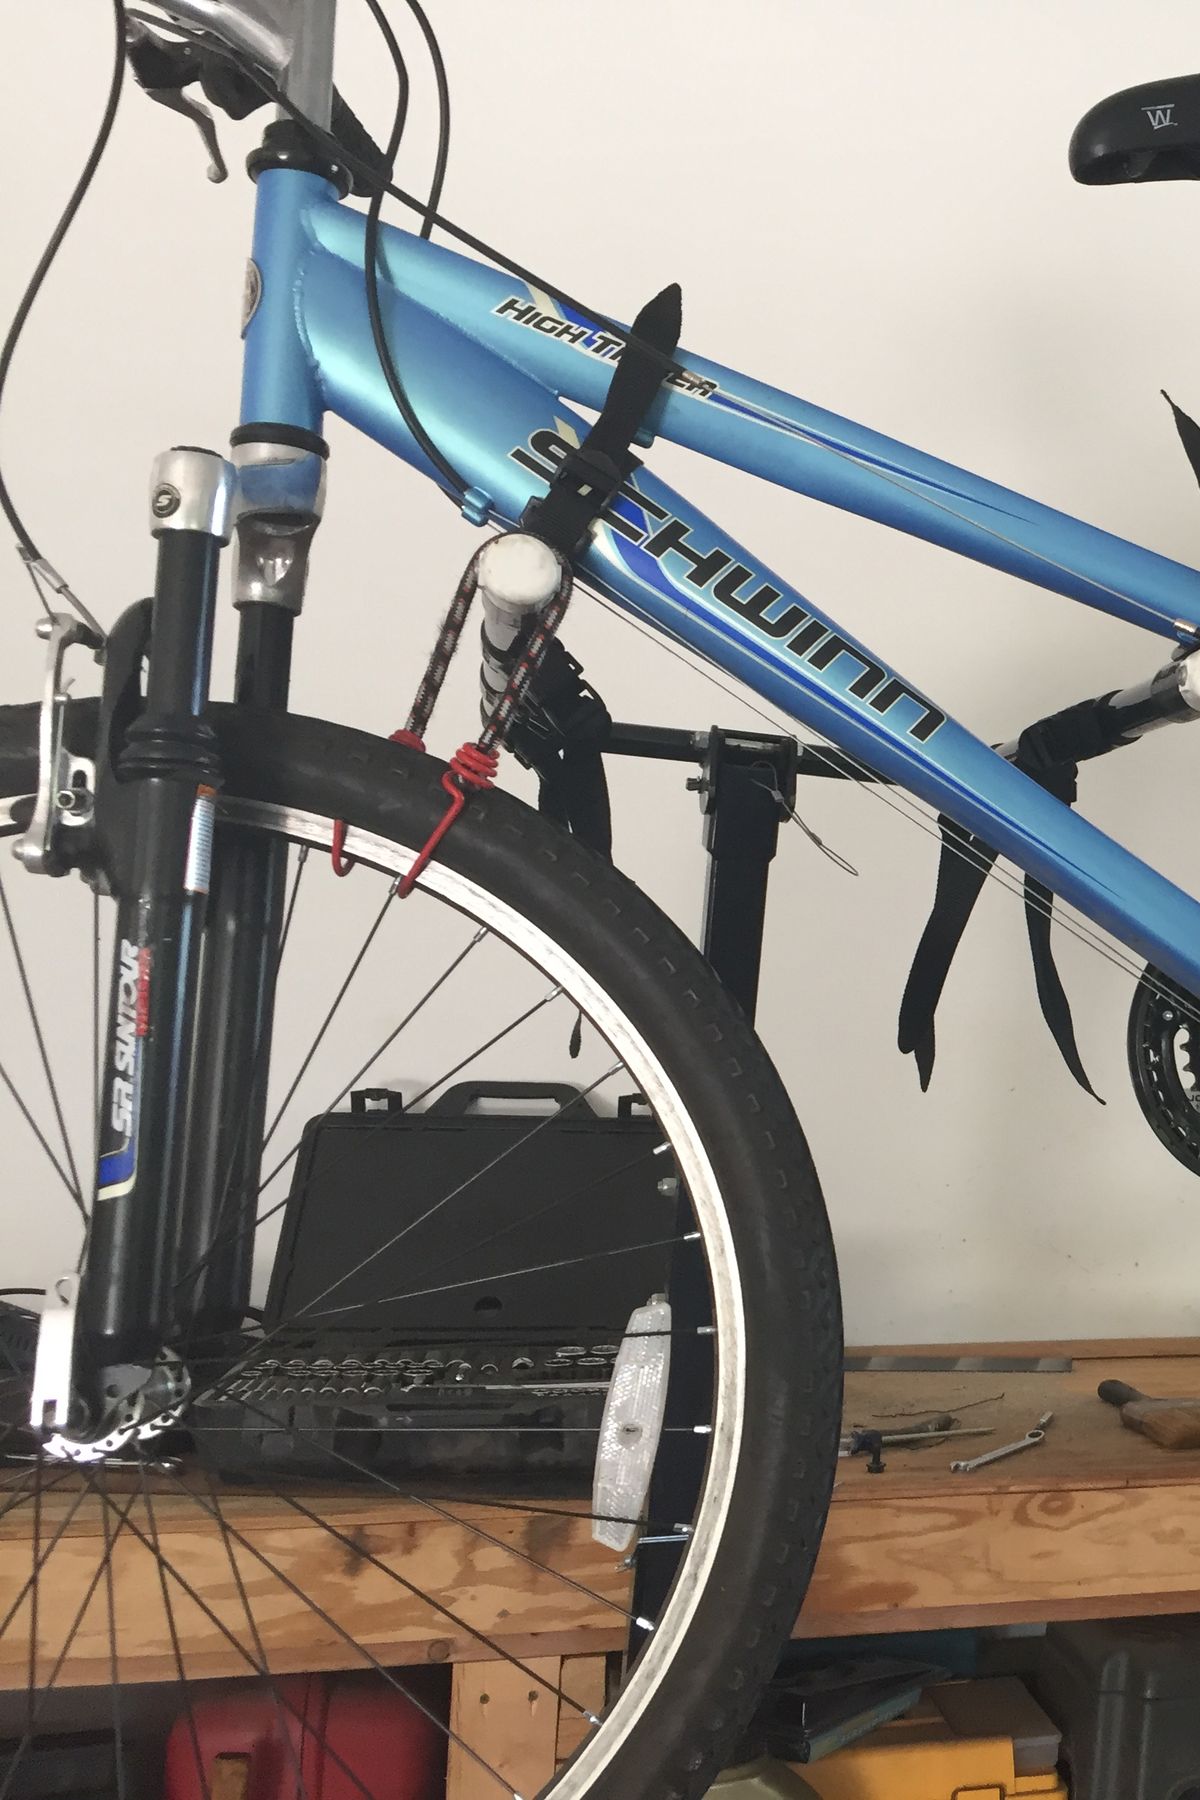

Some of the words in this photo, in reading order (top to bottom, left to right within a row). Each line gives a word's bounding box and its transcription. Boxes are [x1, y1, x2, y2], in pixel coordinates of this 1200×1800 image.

[494, 296, 589, 345] HIGH
[114, 938, 140, 1076] SUNTOUR
[111, 1077, 135, 1137] SR
